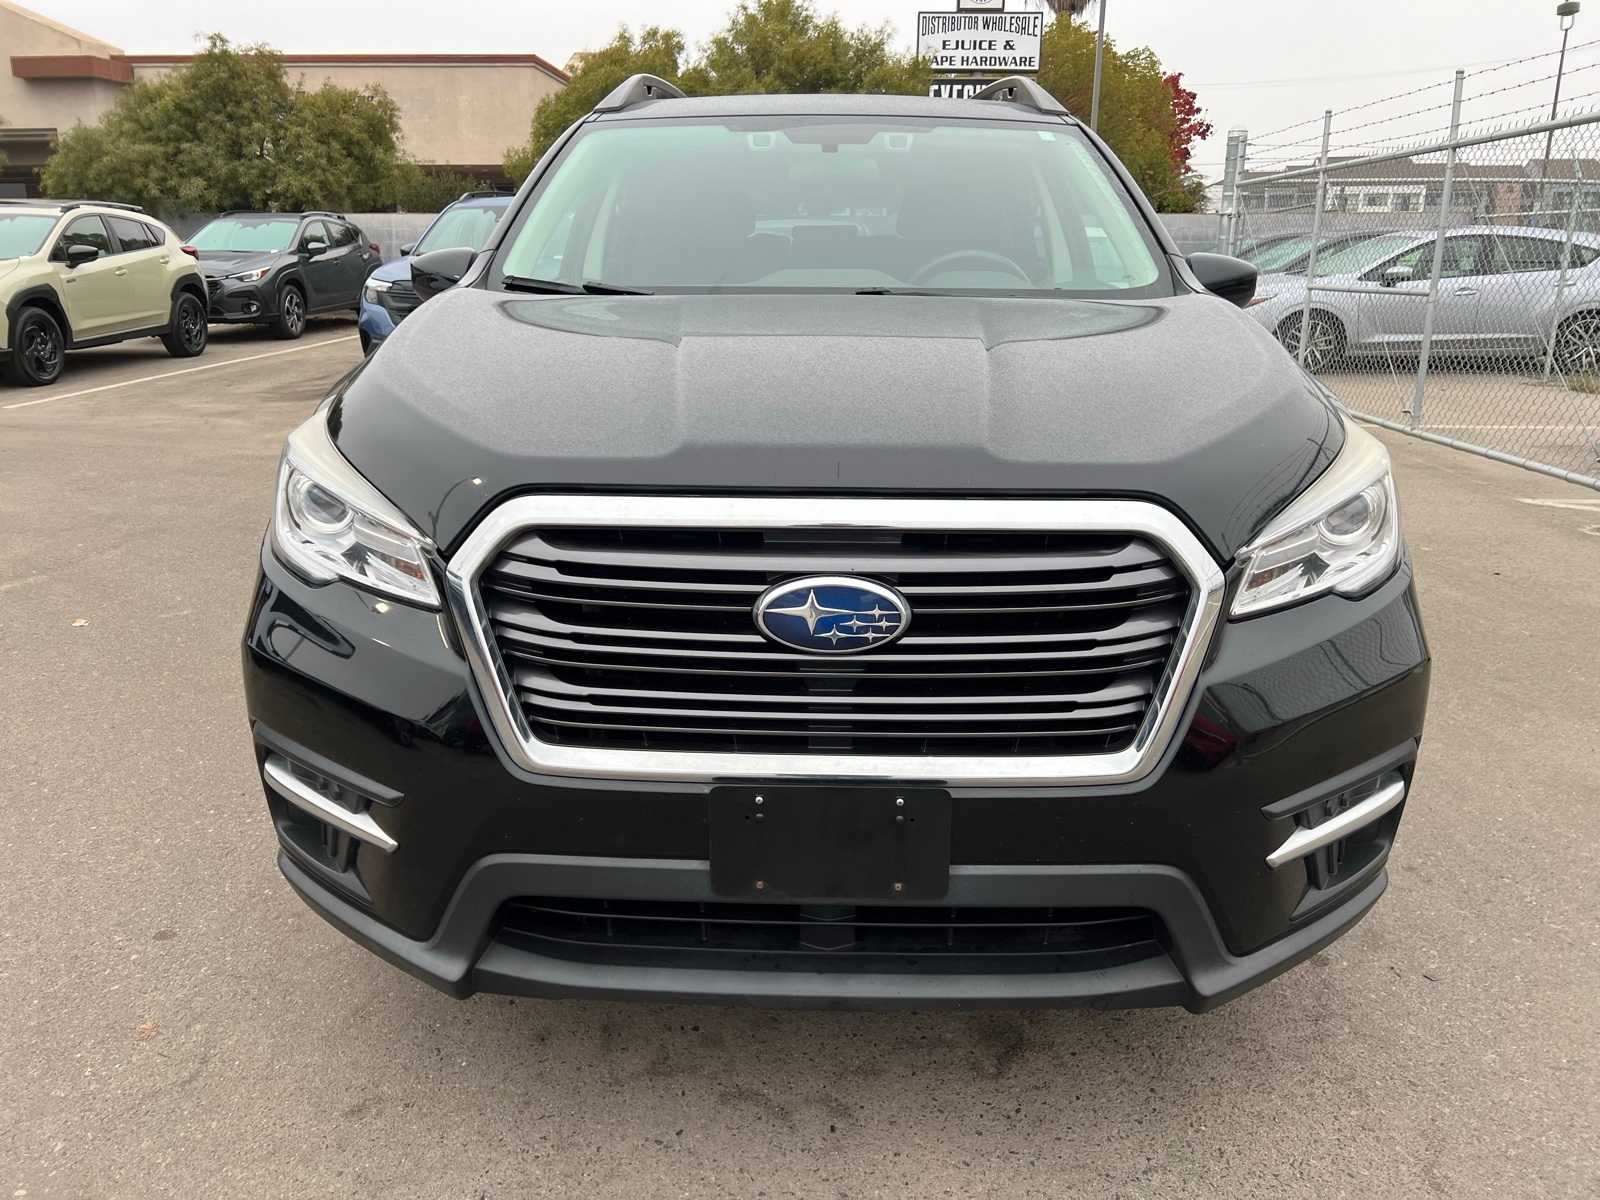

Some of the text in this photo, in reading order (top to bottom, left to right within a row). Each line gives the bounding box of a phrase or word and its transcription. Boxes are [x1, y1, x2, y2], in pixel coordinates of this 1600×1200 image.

[921, 15, 1039, 37] DISTRIBUTOR WHOLESALE
[942, 39, 1016, 51] EJUICE &
[960, 56, 1036, 67] HARDWARE
